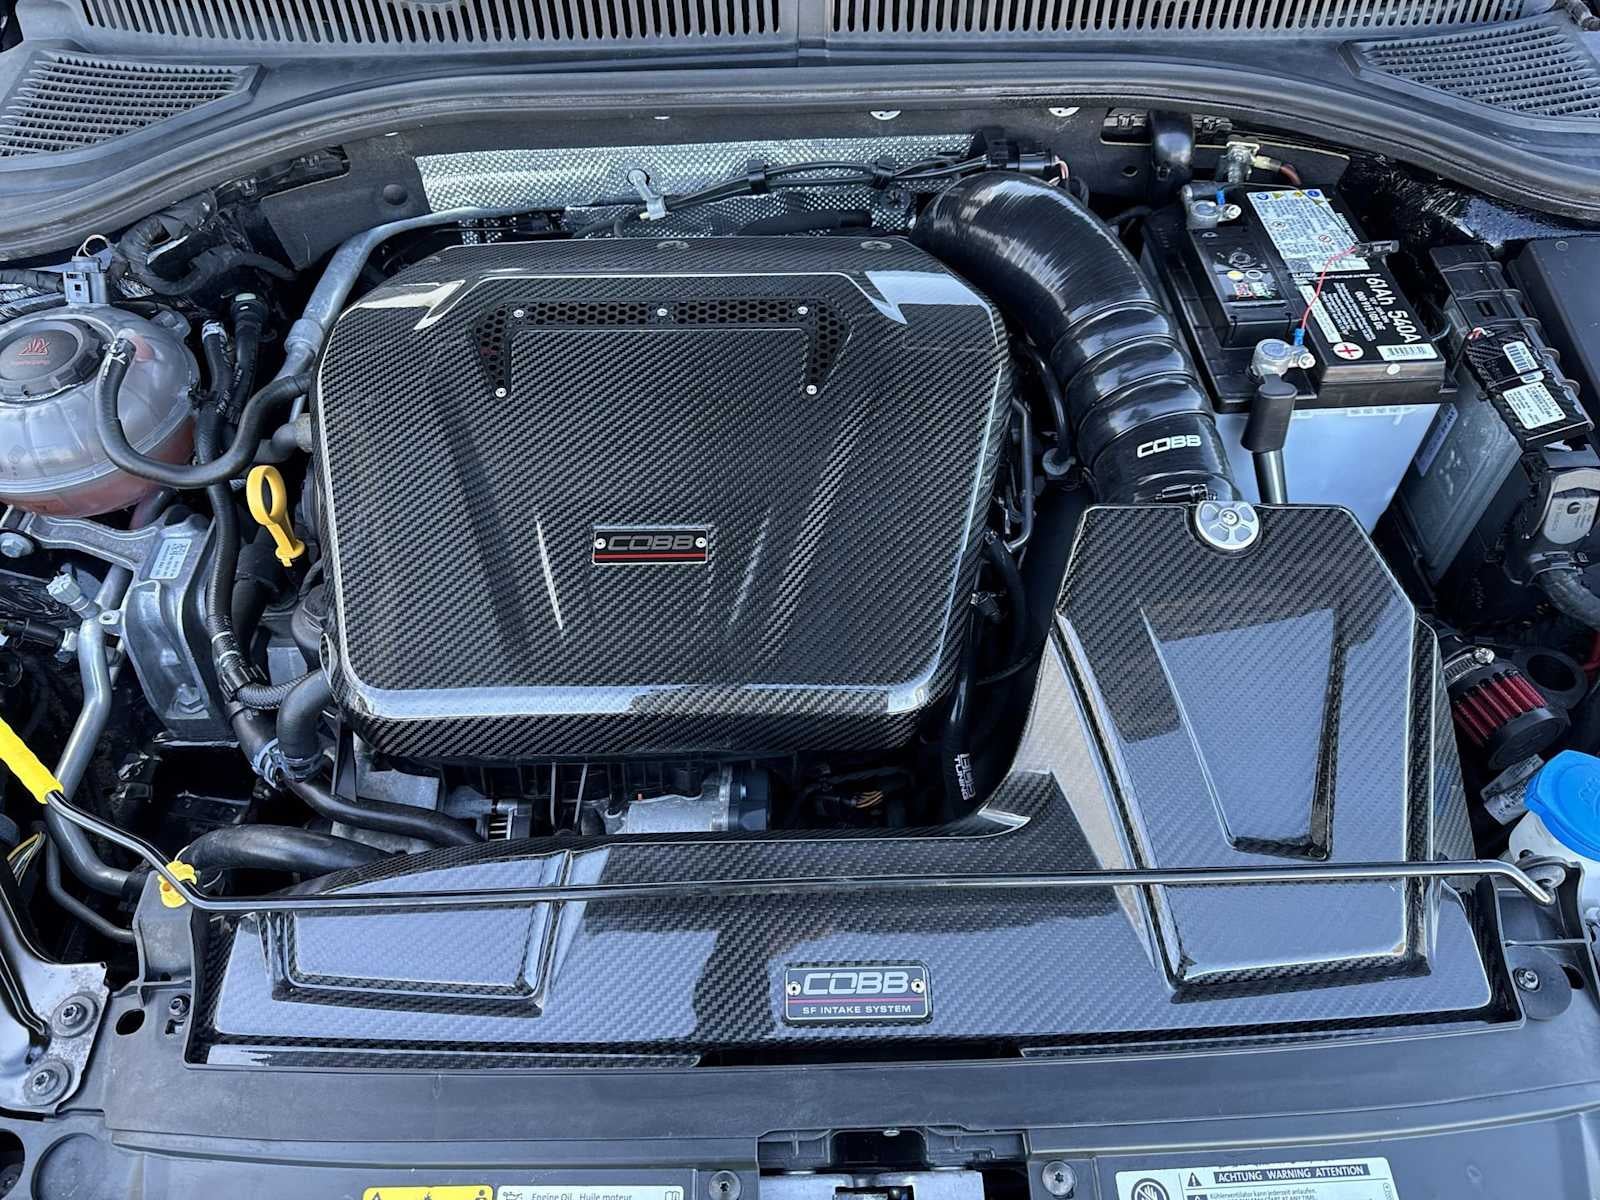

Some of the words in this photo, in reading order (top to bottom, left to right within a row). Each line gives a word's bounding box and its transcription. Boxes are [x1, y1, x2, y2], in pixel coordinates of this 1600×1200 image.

[1366, 277, 1397, 306] 61Ah
[1387, 310, 1422, 344] 540A
[1136, 434, 1202, 459] COBB
[607, 534, 695, 551] COBB
[953, 753, 970, 801] TUNING
[802, 971, 909, 996] COBB
[802, 1006, 817, 1015] SF
[820, 1005, 861, 1014] INTAKE
[865, 1004, 911, 1014] SYSTEM
[1217, 1170, 1262, 1183] ACHTUNG
[1266, 1168, 1312, 1181] WARNING
[1315, 1165, 1364, 1178] ATTENTION
